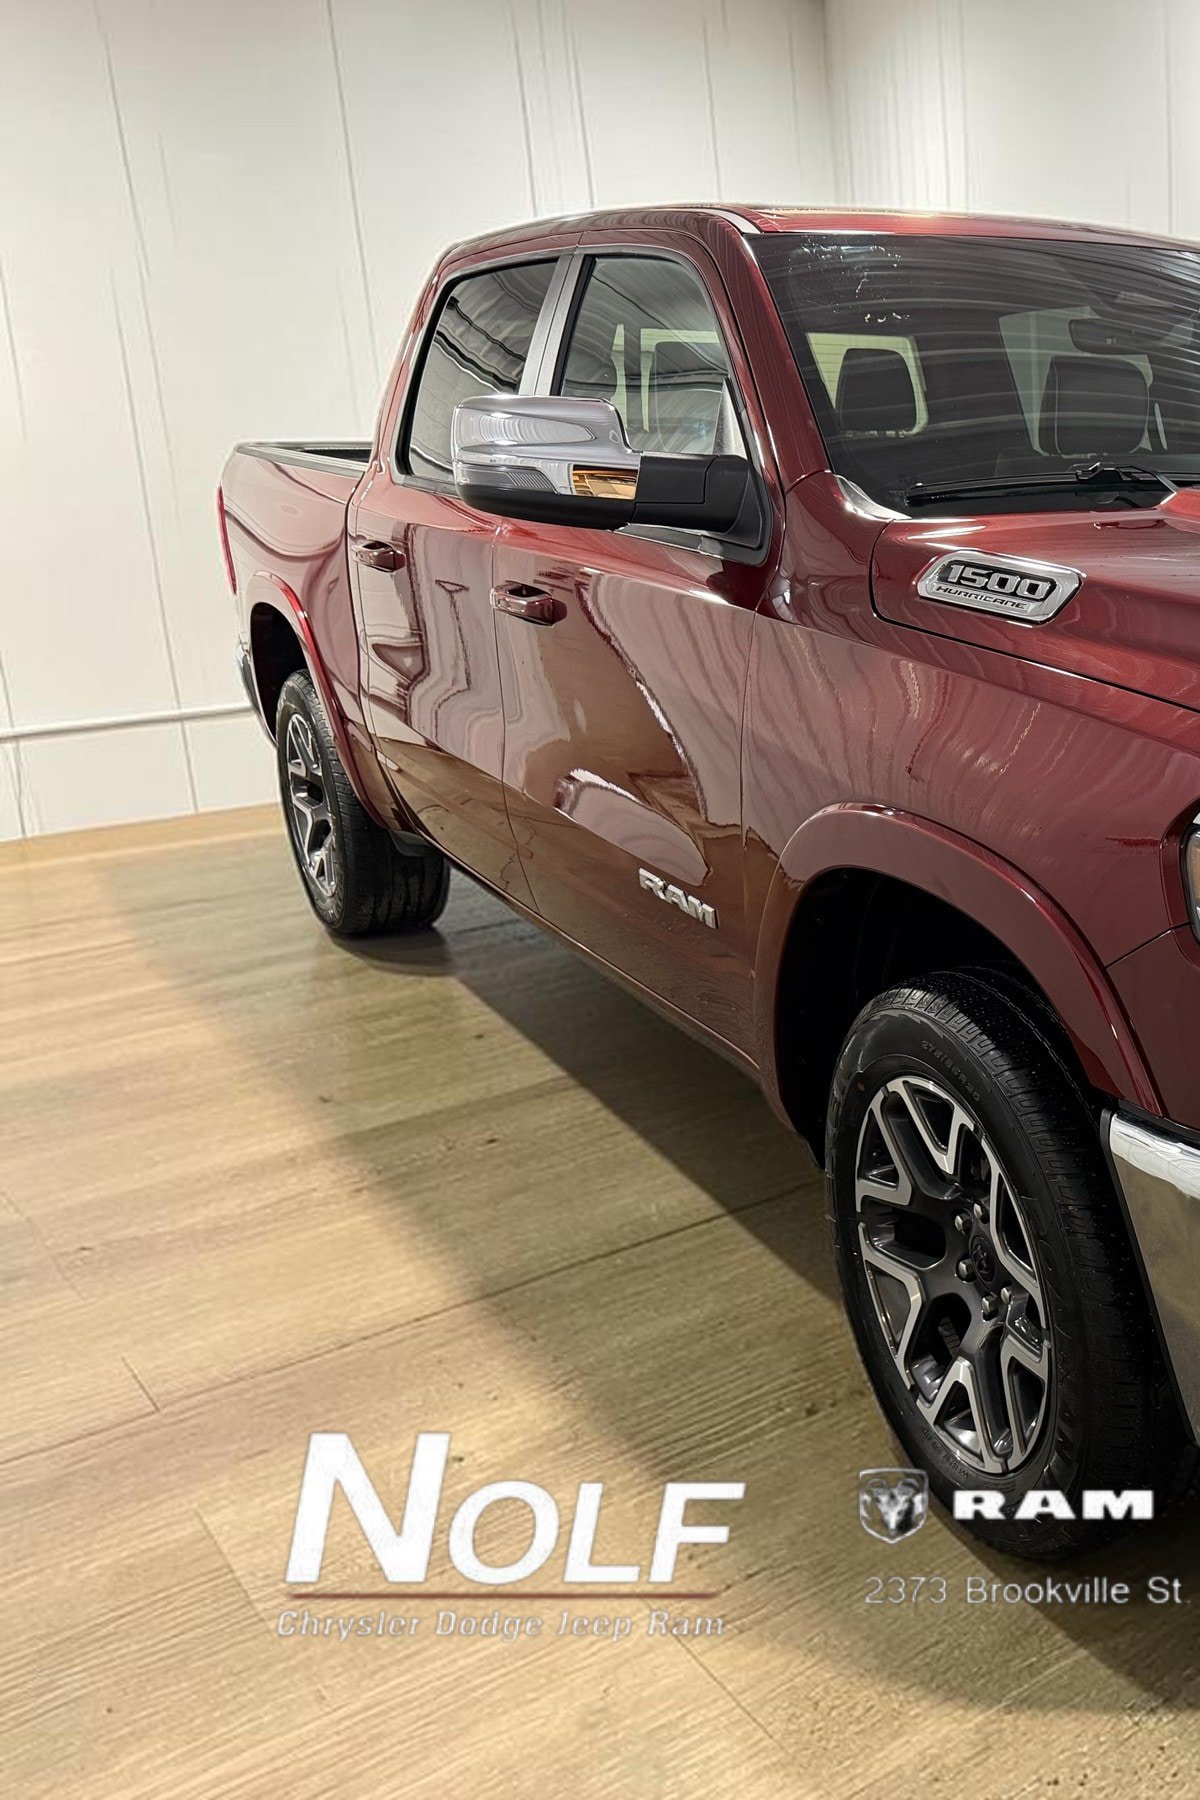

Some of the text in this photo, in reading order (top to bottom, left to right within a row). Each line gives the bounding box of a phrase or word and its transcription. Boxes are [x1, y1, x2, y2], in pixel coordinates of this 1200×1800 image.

[935, 585, 1028, 609] HURRICANE
[947, 564, 1052, 600] 1500
[638, 867, 718, 930] RAM
